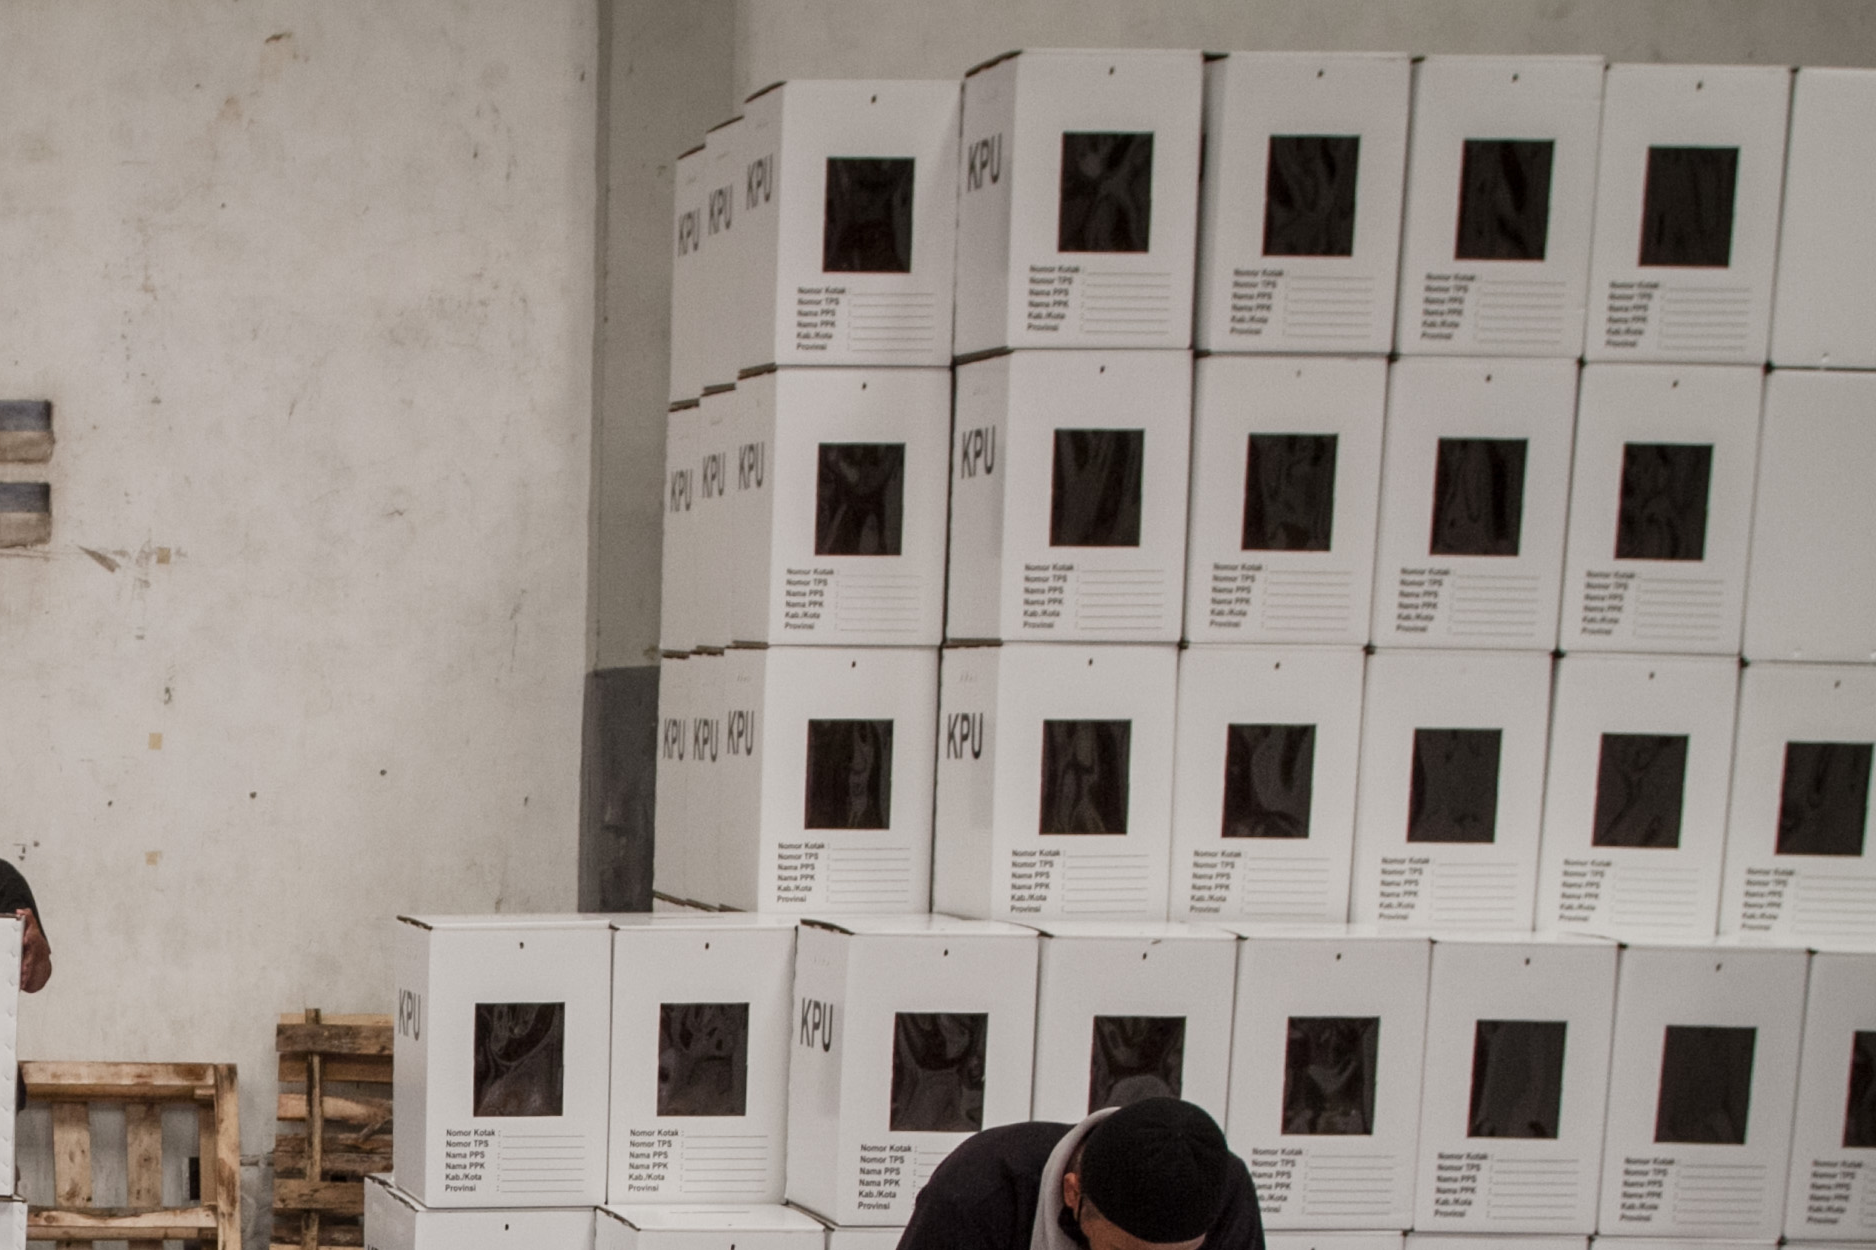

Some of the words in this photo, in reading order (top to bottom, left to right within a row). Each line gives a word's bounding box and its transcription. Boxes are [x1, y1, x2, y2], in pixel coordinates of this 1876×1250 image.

[968, 134, 1002, 191] KPU
[747, 155, 773, 208] KPU
[709, 185, 733, 234] KPU
[678, 211, 700, 256] KPU
[962, 426, 996, 478] KPU
[739, 443, 765, 489] KPU
[703, 454, 726, 498] KPU
[671, 470, 692, 512] KPU
[727, 711, 755, 756] KPU
[947, 713, 984, 760] KPU
[664, 719, 686, 761] KPU
[694, 719, 719, 762] KPU
[777, 842, 803, 851] Nomor
[804, 842, 826, 851] Kotak
[777, 852, 803, 861] Nomor
[804, 852, 819, 861] TPS
[1011, 849, 1037, 858] Nomor
[1038, 848, 1061, 858] Kotak
[777, 863, 799, 871] Nama
[799, 862, 816, 871] PPS
[1011, 860, 1037, 869] Nomor
[1039, 859, 1054, 869] TPS
[777, 874, 798, 882] Nama
[799, 873, 815, 881] PPK
[1011, 871, 1033, 880] Nama
[1034, 870, 1051, 880] PPS
[1010, 882, 1033, 891] Nama
[1033, 881, 1050, 890] PPK
[776, 894, 807, 903] Provinsi
[1010, 904, 1042, 914] Provinsi
[399, 989, 421, 1041] KPU
[801, 999, 834, 1052] KPU
[446, 1128, 472, 1137] Nomor
[473, 1128, 496, 1137] Kotak
[629, 1128, 656, 1137] Nomor
[656, 1128, 679, 1137] Kotak
[445, 1139, 472, 1148] Nomor
[473, 1139, 490, 1148] TPS
[629, 1139, 655, 1148] Nomor
[657, 1139, 673, 1148] TPS
[860, 1144, 887, 1152] Nomor
[889, 1145, 912, 1153] Kotak
[445, 1151, 468, 1160] Nama
[469, 1150, 486, 1159] PPS
[628, 1151, 651, 1160] Nama
[652, 1150, 669, 1160] PPS
[860, 1155, 887, 1164] Nomor
[889, 1155, 905, 1164] TPS
[445, 1162, 468, 1170] Nama
[468, 1161, 485, 1170] PPK
[628, 1162, 651, 1171] Nama
[652, 1161, 668, 1170] PPK
[859, 1167, 882, 1175] Nama
[884, 1167, 901, 1176] PPS
[445, 1173, 482, 1181] Kab./Kota
[628, 1173, 665, 1181] Kab./Kota
[444, 1183, 477, 1192] Provinsi
[628, 1183, 659, 1192] Provinsi
[858, 1178, 882, 1187] Nama
[883, 1178, 900, 1187] PPK
[857, 1200, 890, 1210] Provinsi
